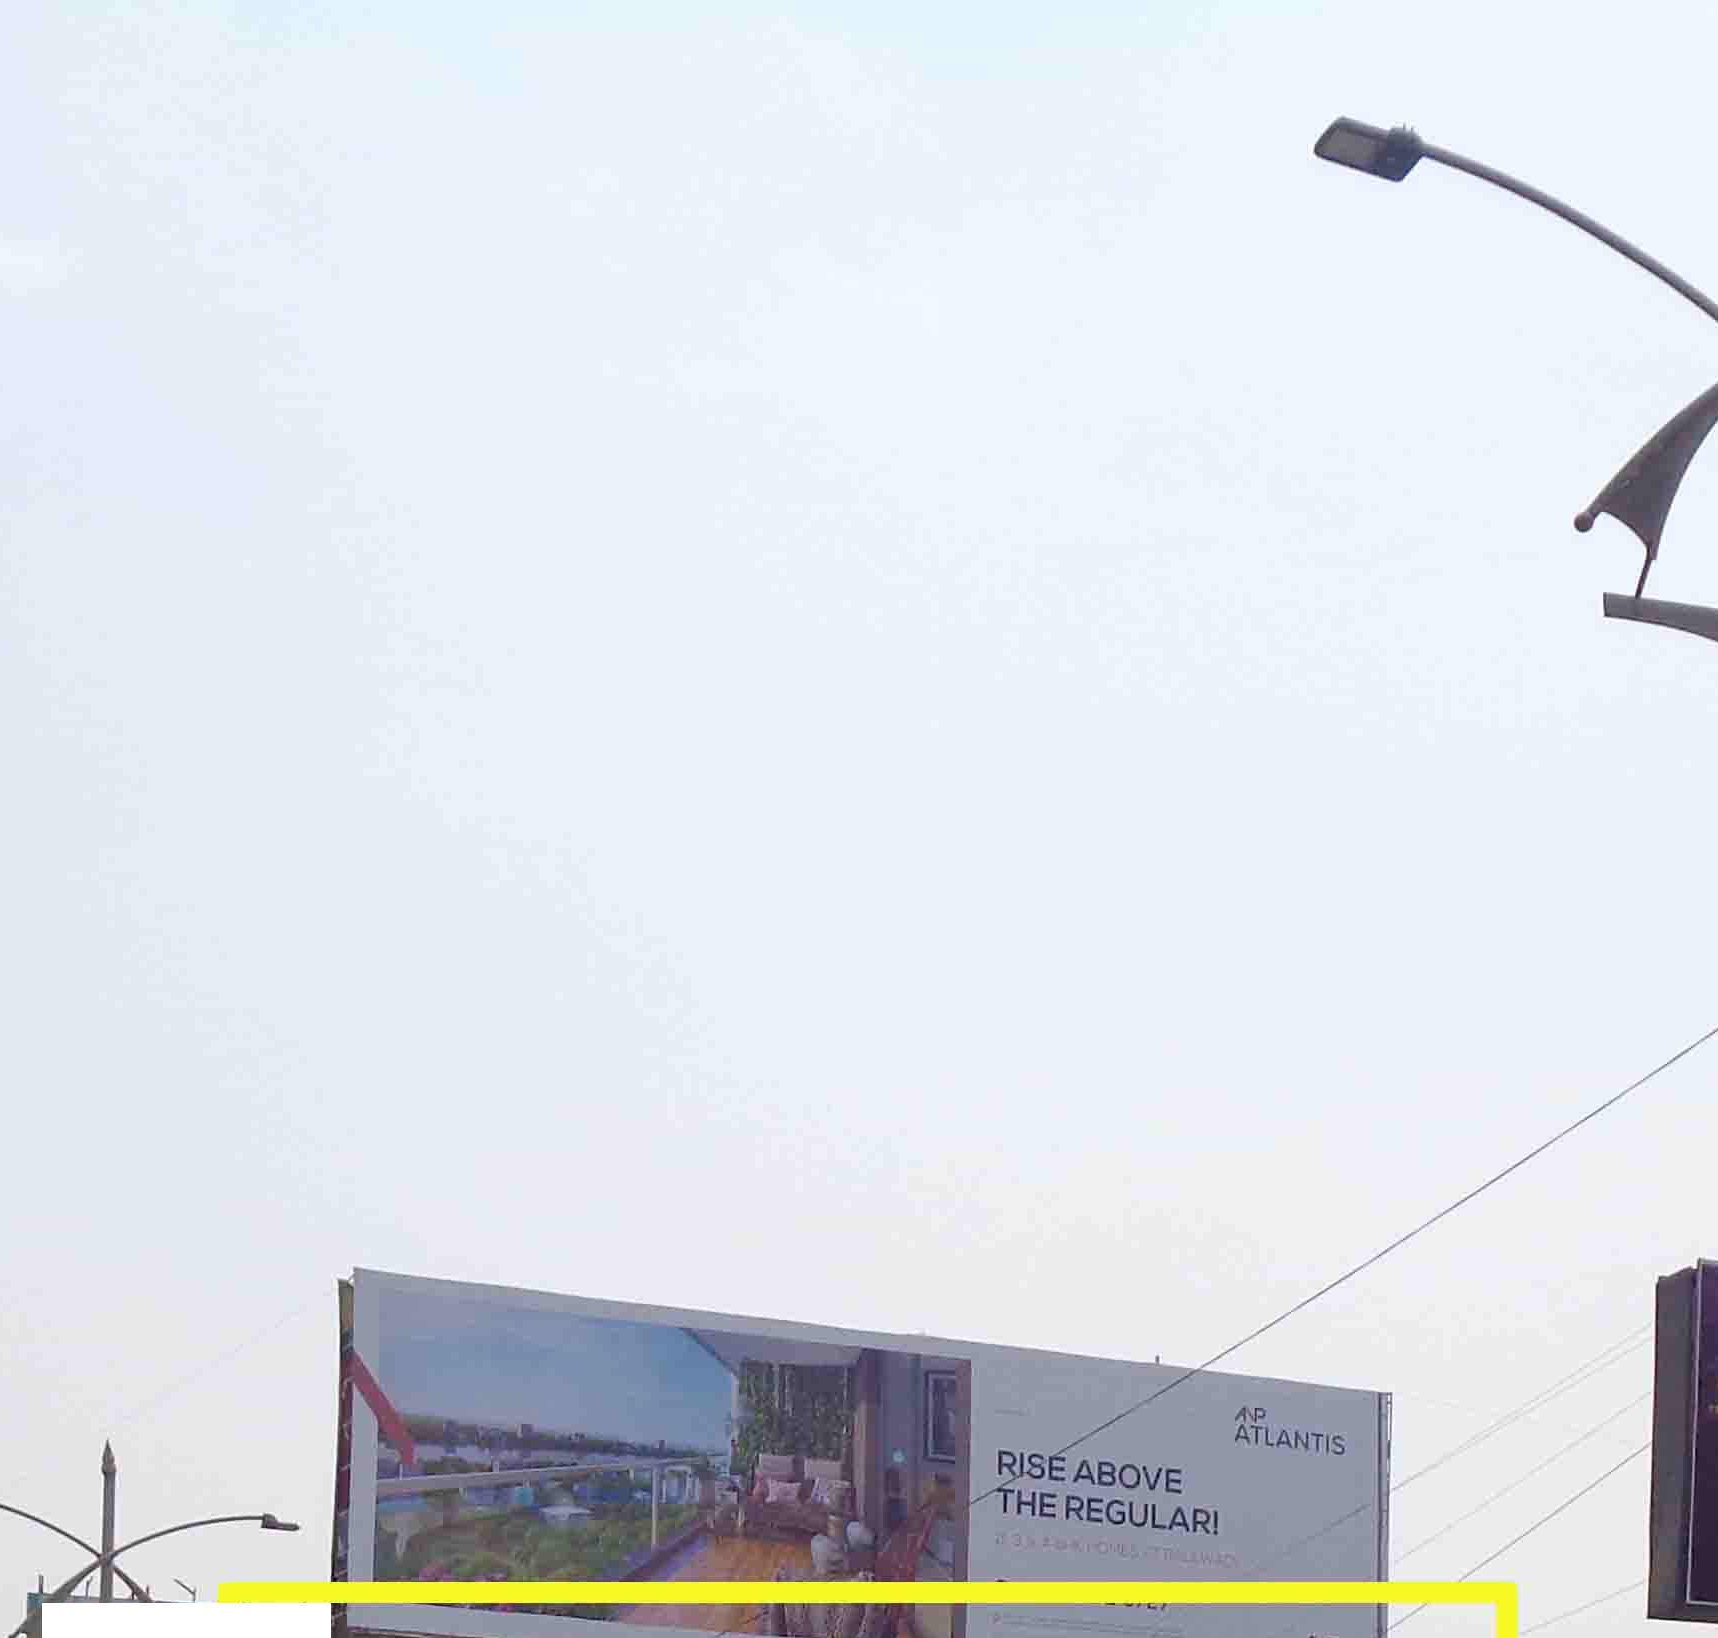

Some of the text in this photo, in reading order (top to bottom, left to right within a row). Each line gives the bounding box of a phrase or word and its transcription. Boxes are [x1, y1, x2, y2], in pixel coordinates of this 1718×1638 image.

[1234, 1424, 1347, 1456] ATLANTIS
[996, 1450, 1183, 1494] RISE ABOVE
[996, 1488, 1220, 1536] THE REGULAR!
